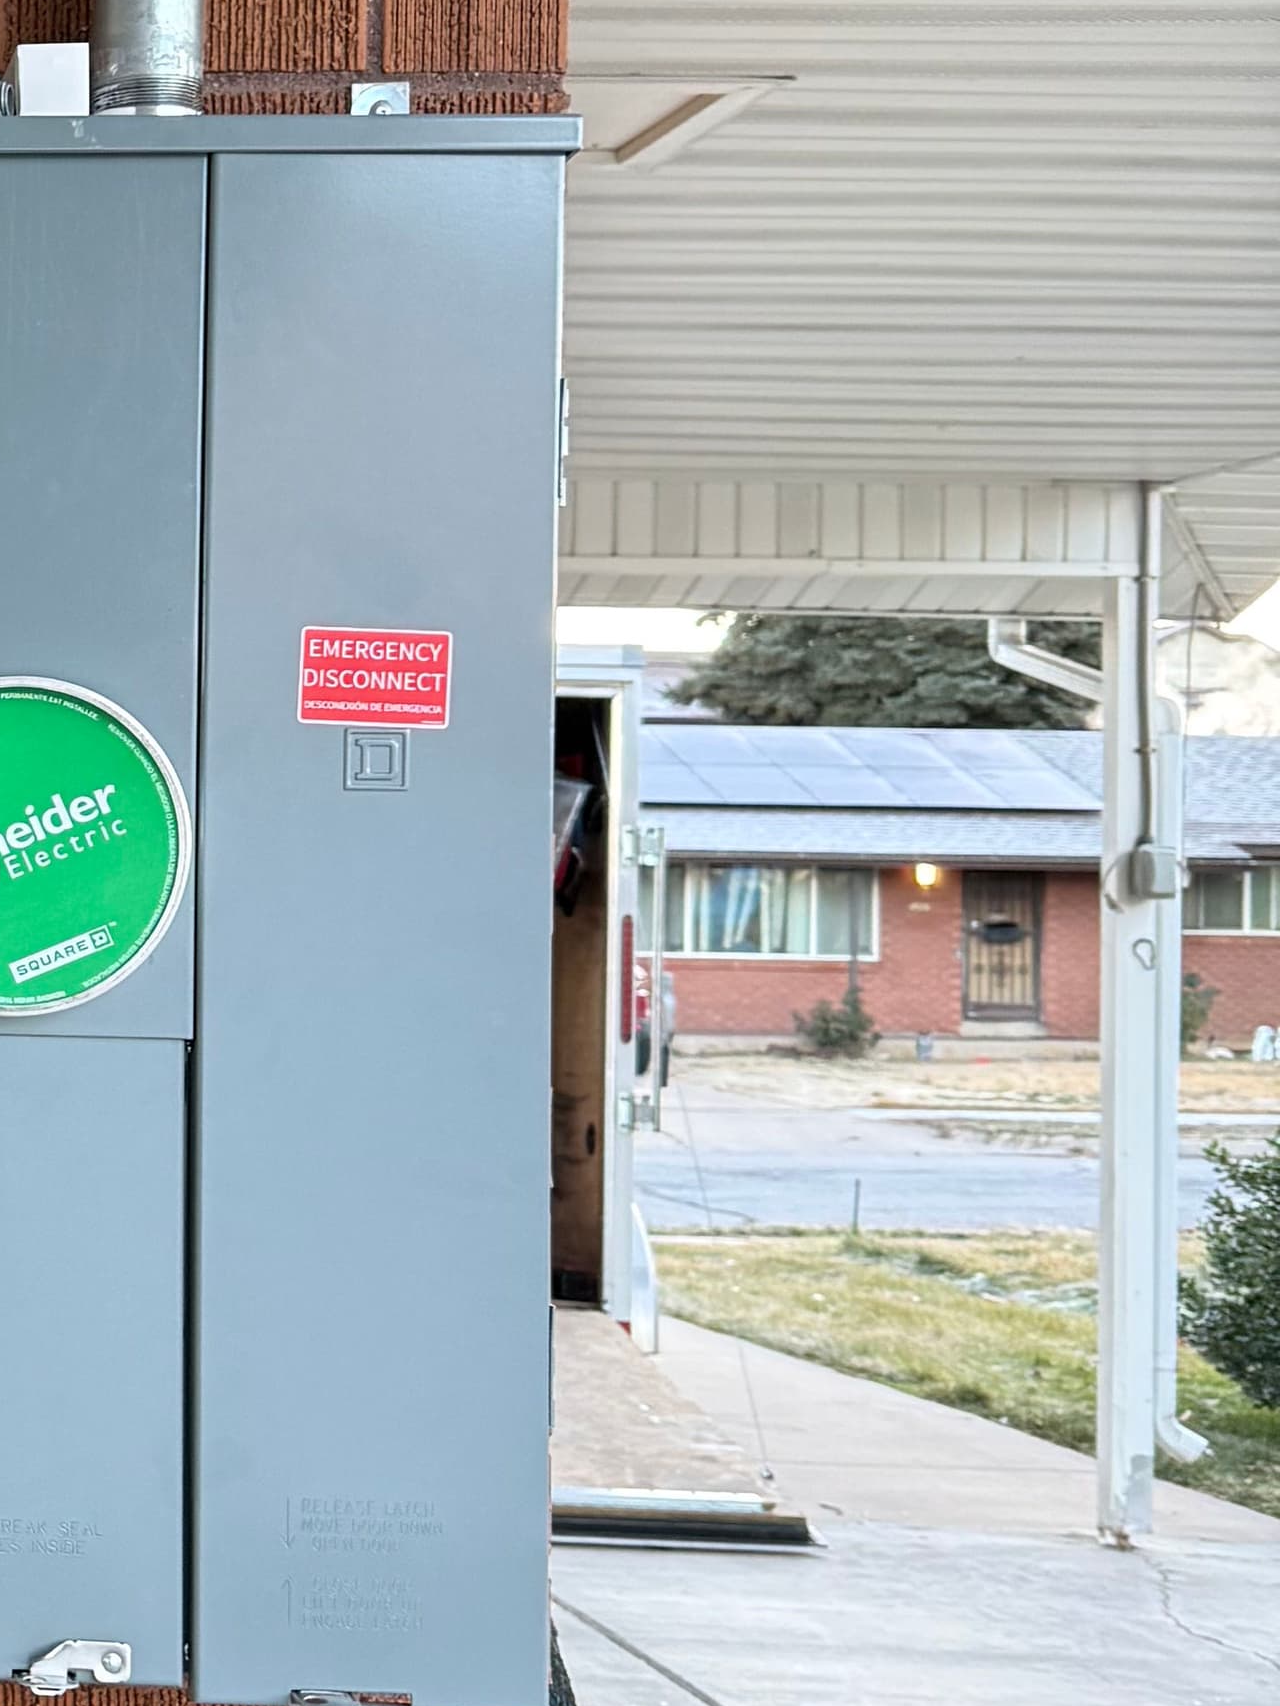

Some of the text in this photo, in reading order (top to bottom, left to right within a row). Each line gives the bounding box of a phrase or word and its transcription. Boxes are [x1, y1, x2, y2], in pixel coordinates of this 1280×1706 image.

[308, 639, 443, 662] EMERGENCY
[302, 668, 446, 692] DISCONNECT
[3, 818, 128, 880] Electric
[16, 939, 89, 976] SQUARE
[57, 1520, 104, 1538] SEAL
